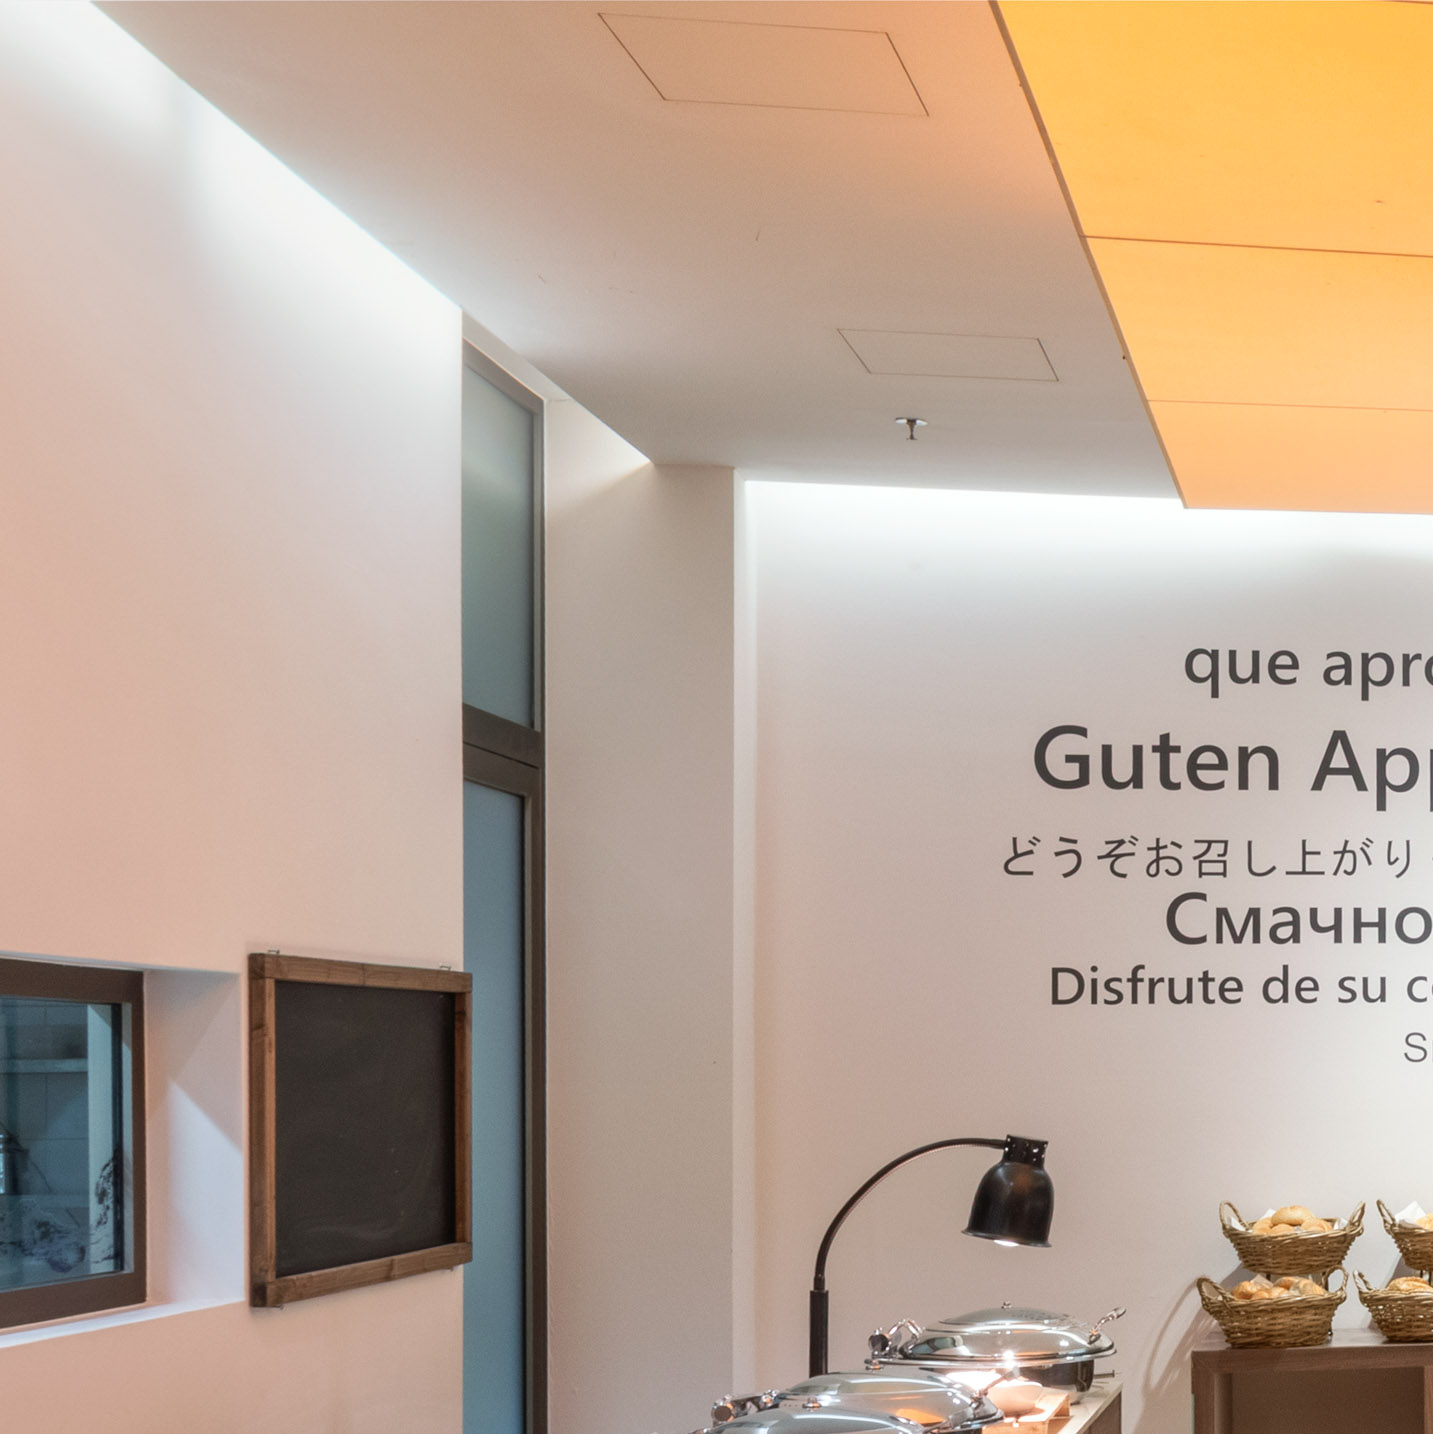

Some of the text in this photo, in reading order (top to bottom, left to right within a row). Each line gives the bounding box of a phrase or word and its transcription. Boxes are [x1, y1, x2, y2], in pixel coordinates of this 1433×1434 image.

[1184, 647, 1300, 700] que
[1033, 724, 1280, 792] Guten
[1051, 963, 1244, 1006] Disfrute
[1261, 963, 1320, 1005] de
[1337, 975, 1387, 1004] su
